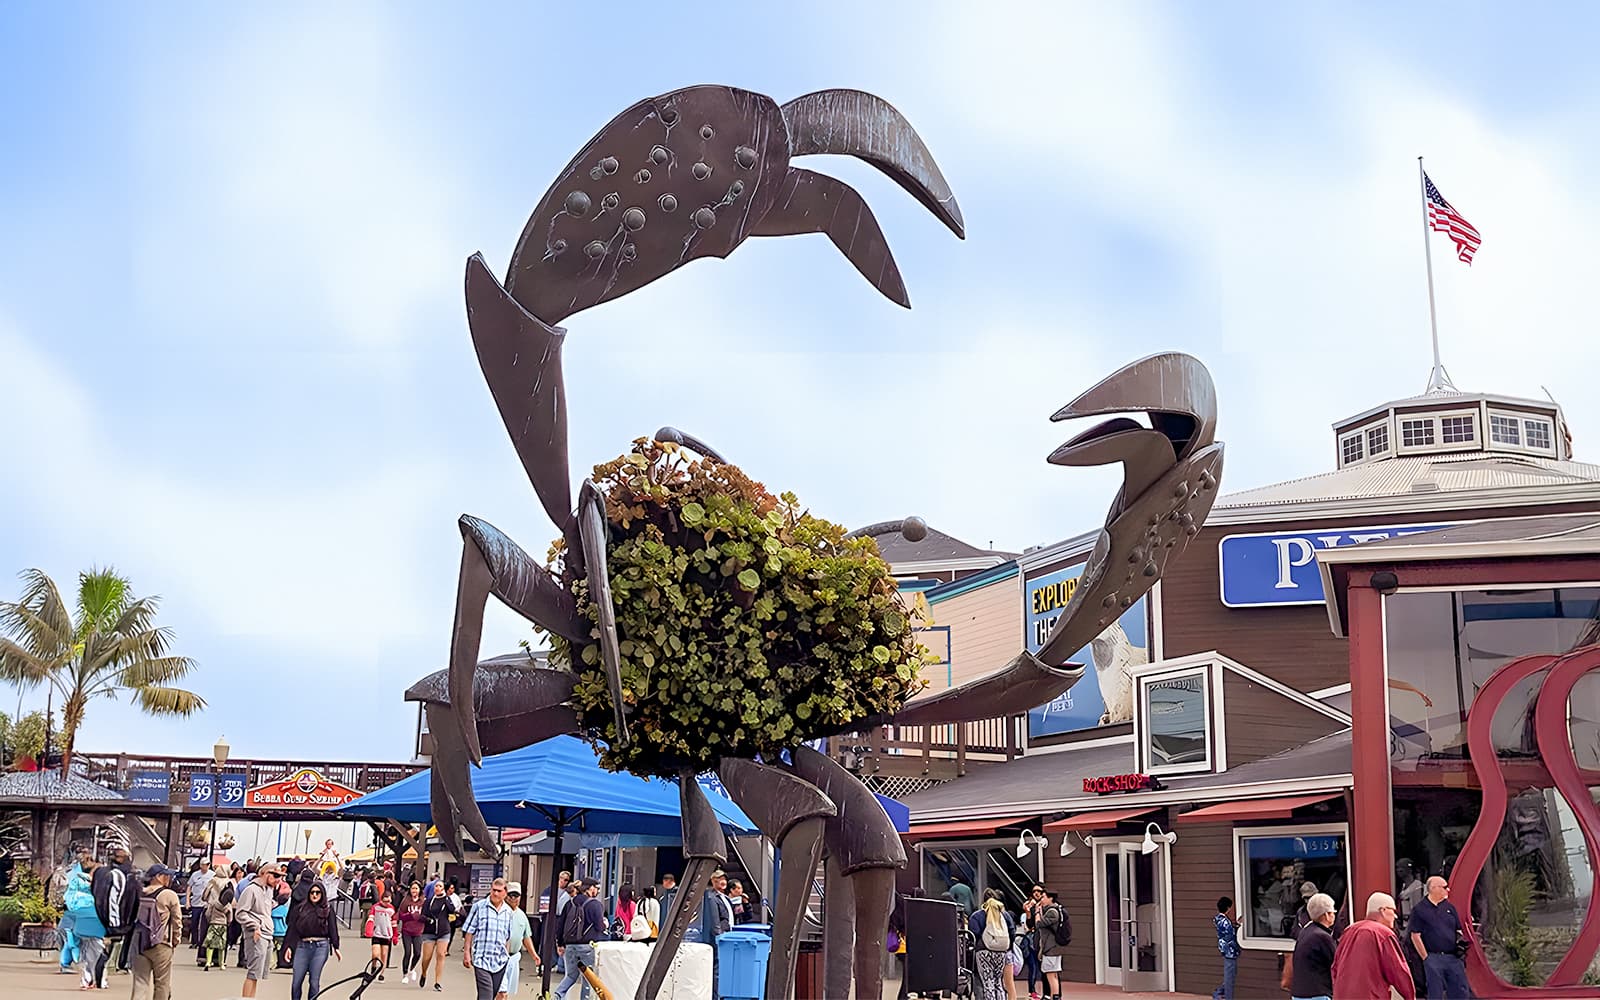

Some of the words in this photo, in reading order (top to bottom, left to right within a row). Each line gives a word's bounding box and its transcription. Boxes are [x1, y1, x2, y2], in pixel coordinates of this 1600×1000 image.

[1032, 576, 1081, 614] EXPLOR
[1083, 777, 1111, 792] ROCK
[1114, 774, 1143, 791] SHOP
[191, 786, 212, 802] 39
[222, 787, 243, 803] 39
